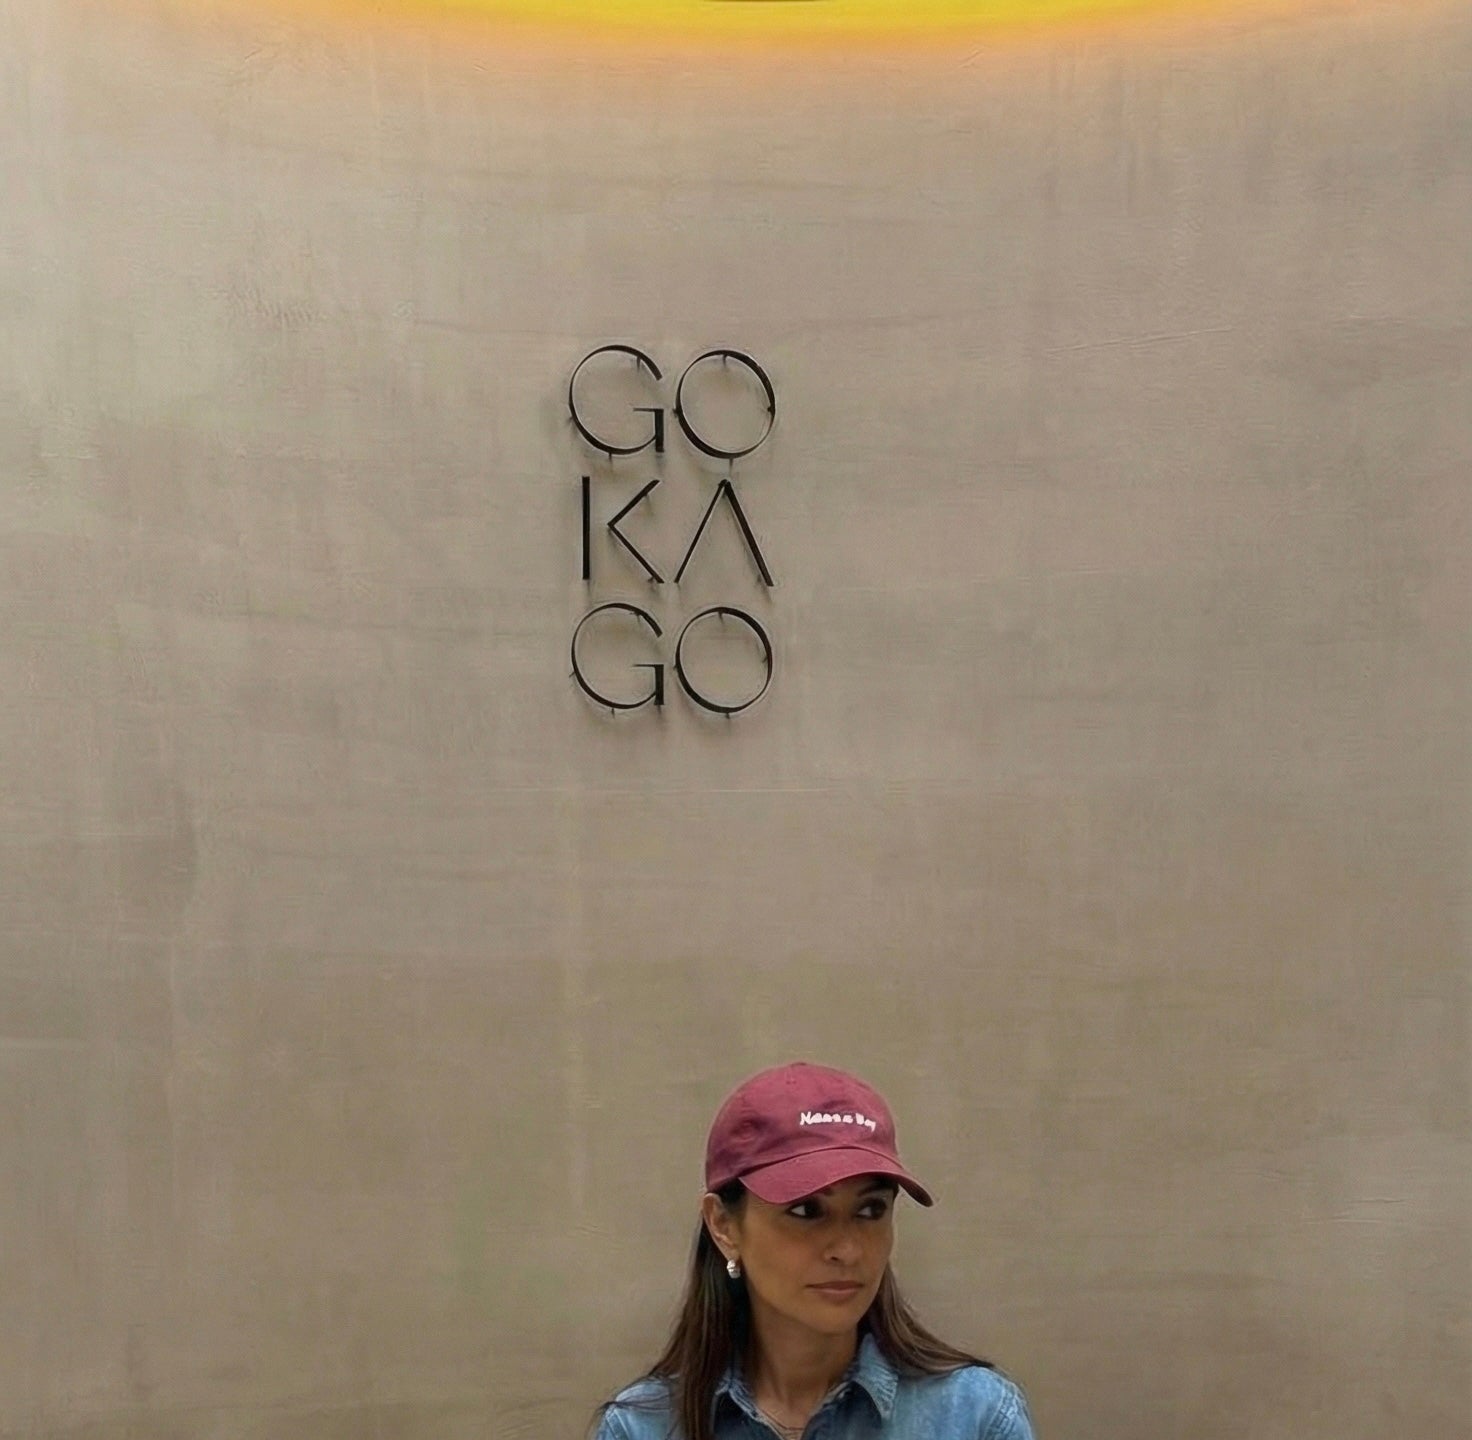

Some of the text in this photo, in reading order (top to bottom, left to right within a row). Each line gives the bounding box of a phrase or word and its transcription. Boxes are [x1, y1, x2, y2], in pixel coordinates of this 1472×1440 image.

[569, 345, 775, 459] GO
[582, 475, 774, 586] KA
[571, 602, 773, 713] GO
